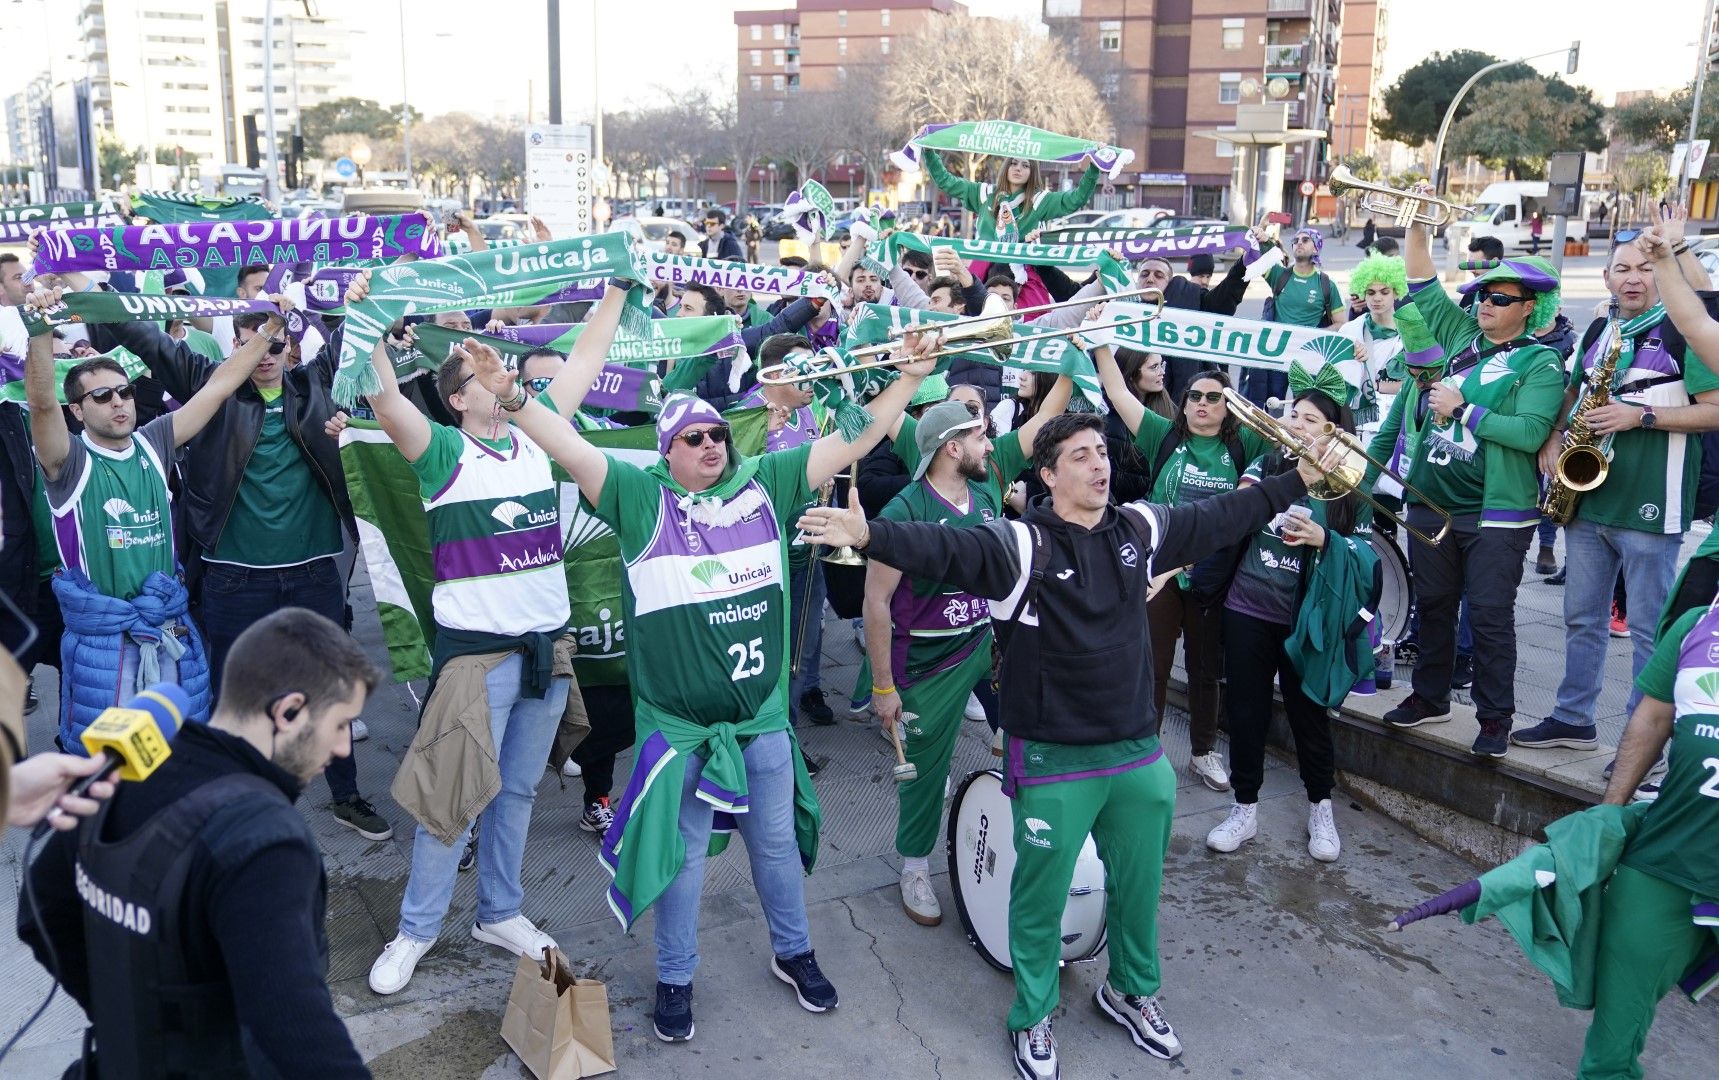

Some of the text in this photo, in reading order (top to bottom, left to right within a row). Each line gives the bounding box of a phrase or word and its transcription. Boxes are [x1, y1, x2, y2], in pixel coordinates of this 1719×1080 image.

[973, 121, 1031, 141] UNICAJA
[958, 133, 1041, 155] BALONCESTO
[0, 202, 126, 238] ICAJA
[963, 237, 1099, 263] Unicaja
[1057, 225, 1227, 254] UNICAJA
[494, 239, 610, 275] Unicaja
[415, 277, 465, 295] Unicaja
[691, 269, 781, 293] MALAGA
[1182, 475, 1234, 490] boquerona
[728, 561, 772, 585] Unicaja
[727, 636, 766, 682] 25
[1025, 832, 1052, 847] Unicaja
